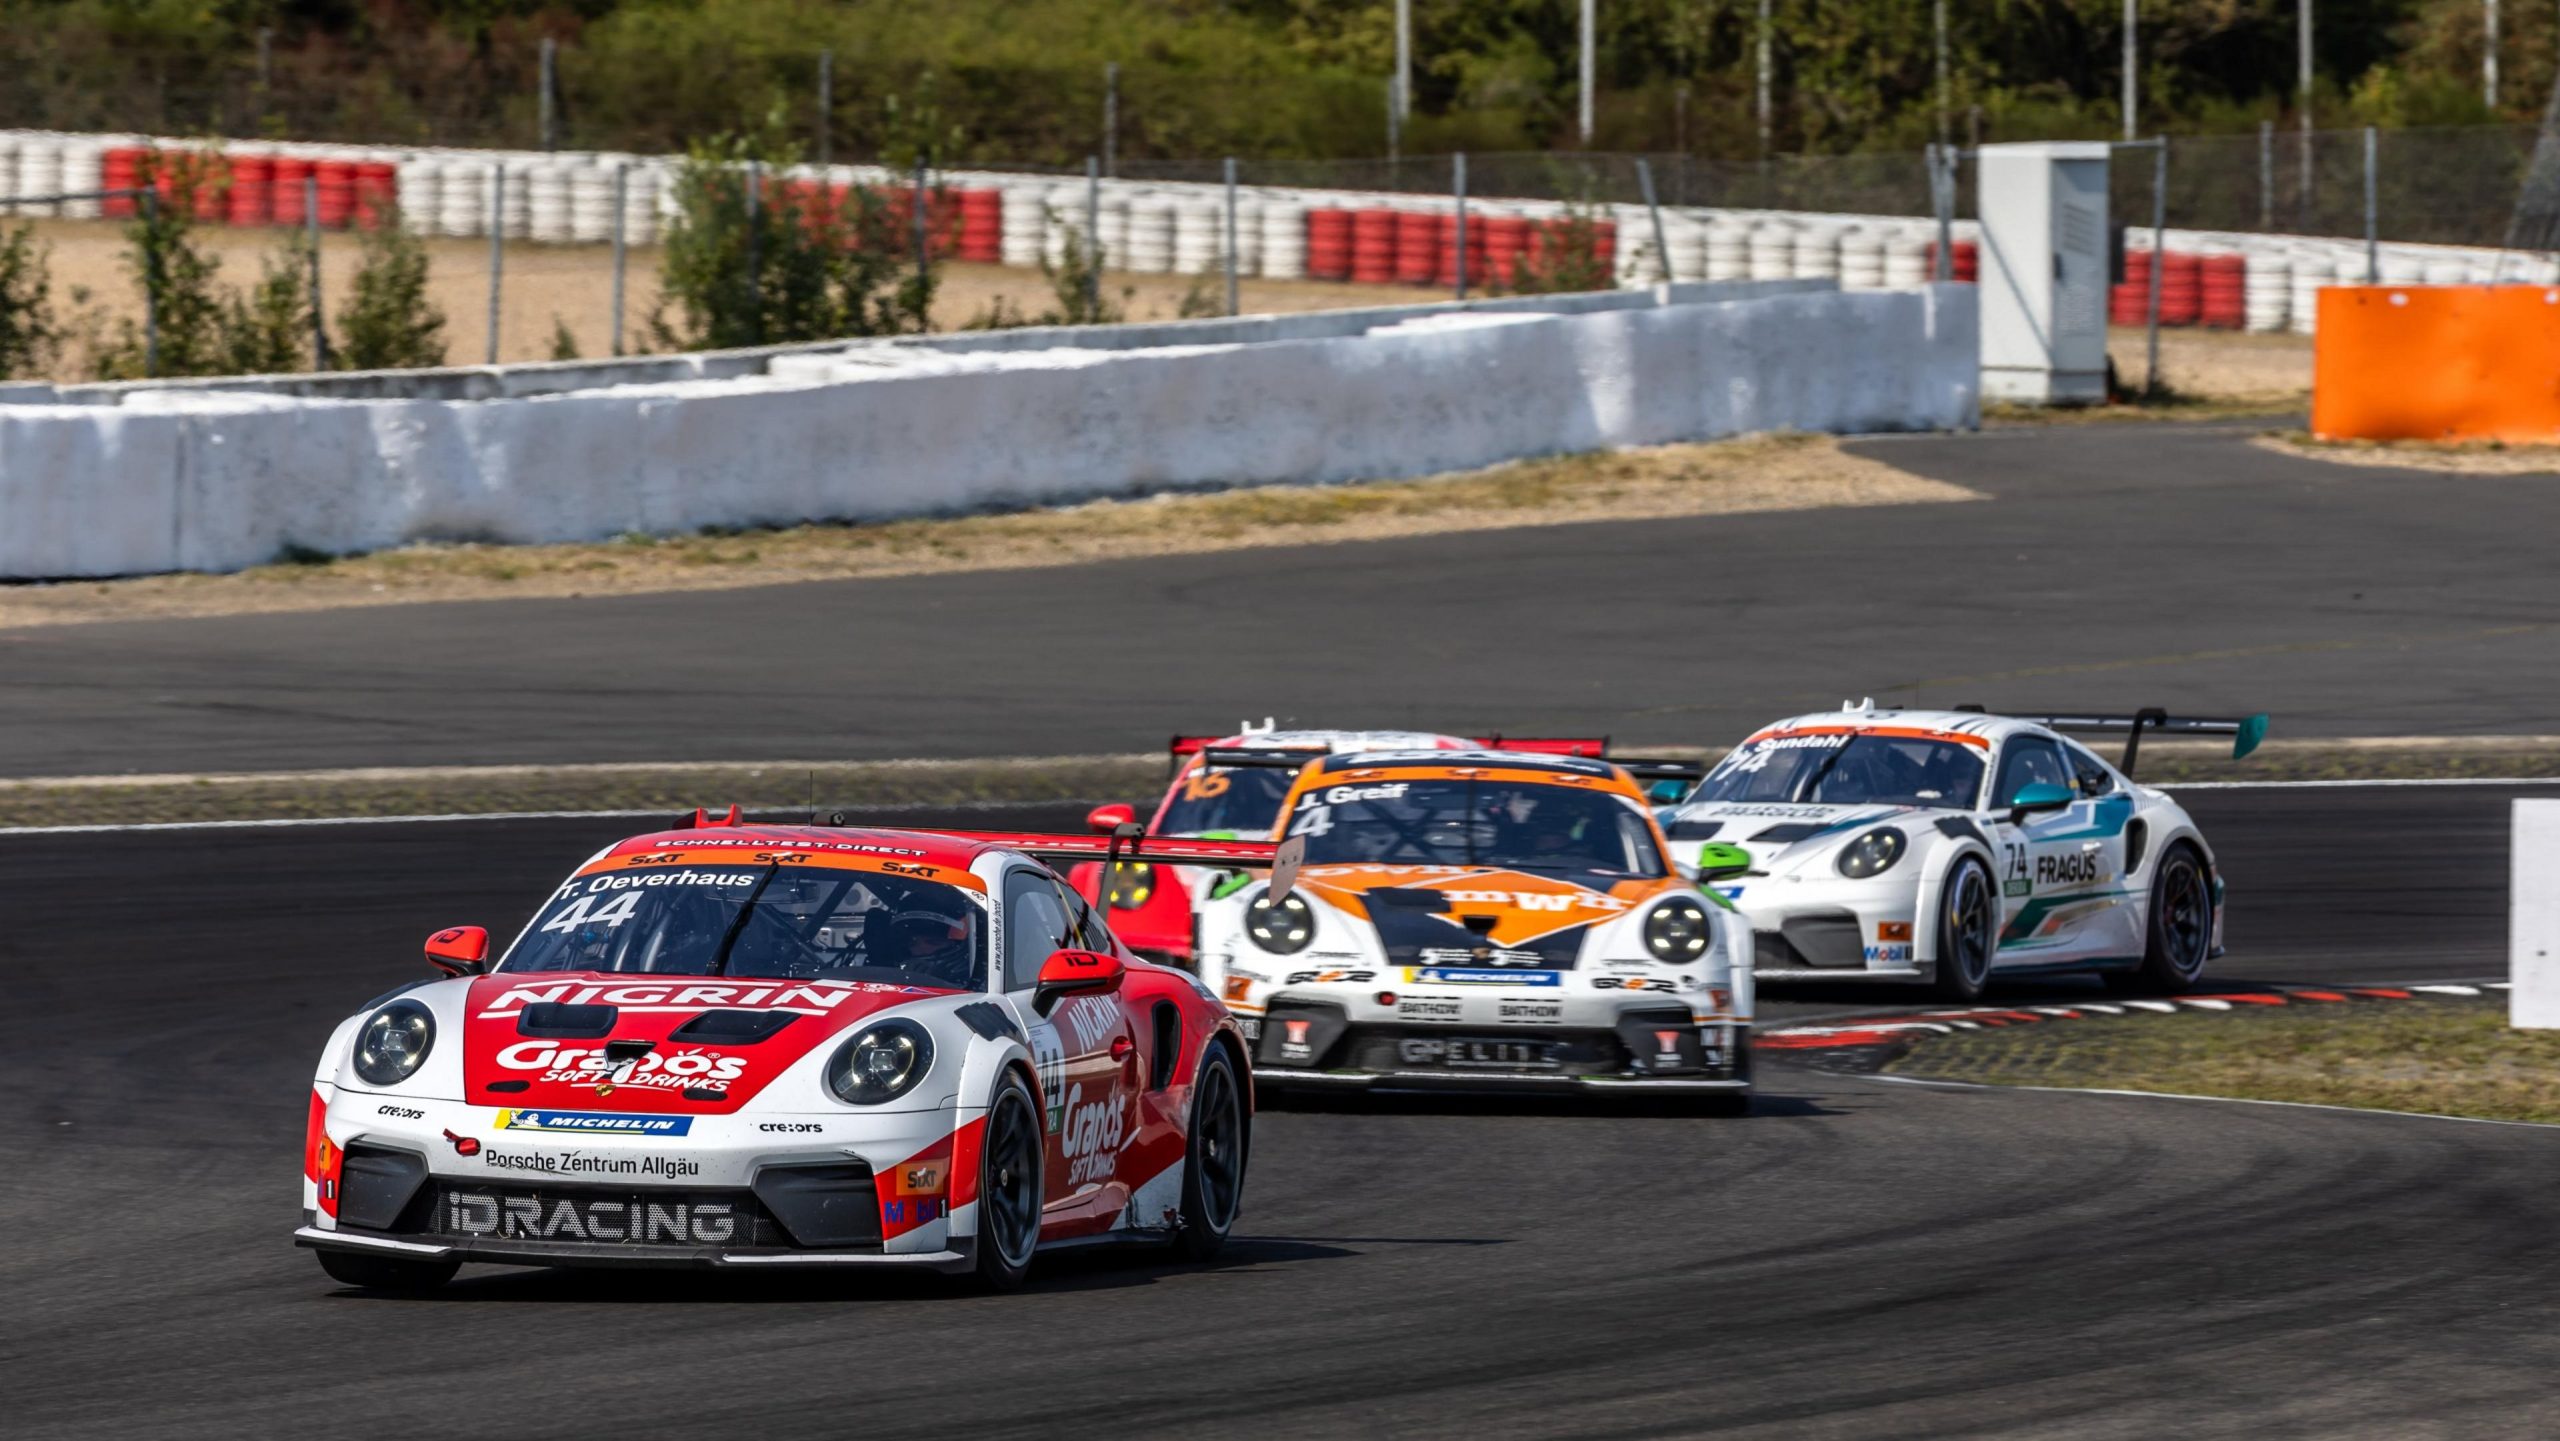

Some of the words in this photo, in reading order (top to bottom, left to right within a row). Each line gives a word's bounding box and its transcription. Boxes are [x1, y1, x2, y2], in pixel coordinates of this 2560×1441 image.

[1755, 733, 1851, 753] Sundahl
[1714, 748, 1776, 782] 74
[1325, 783, 1410, 804] Greif
[1289, 805, 1335, 837] 4
[655, 838, 928, 857] SCHNELLTEST.DIRECT
[2004, 842, 2028, 880] 74
[2036, 852, 2097, 884] FRAGUS
[560, 881, 583, 900] T.
[588, 869, 755, 893] Oeverhaus
[540, 890, 645, 934] 44
[1061, 951, 1099, 967] iD
[487, 985, 853, 1010] NIGRIN
[540, 1069, 607, 1083] SOFT
[629, 1072, 731, 1093] DRINKS
[548, 1116, 677, 1131] MICHELIN
[485, 1149, 557, 1170] Porsche
[560, 1152, 637, 1174] Zentrum
[640, 1156, 700, 1180] Allgäu
[907, 1170, 937, 1189] SIXT
